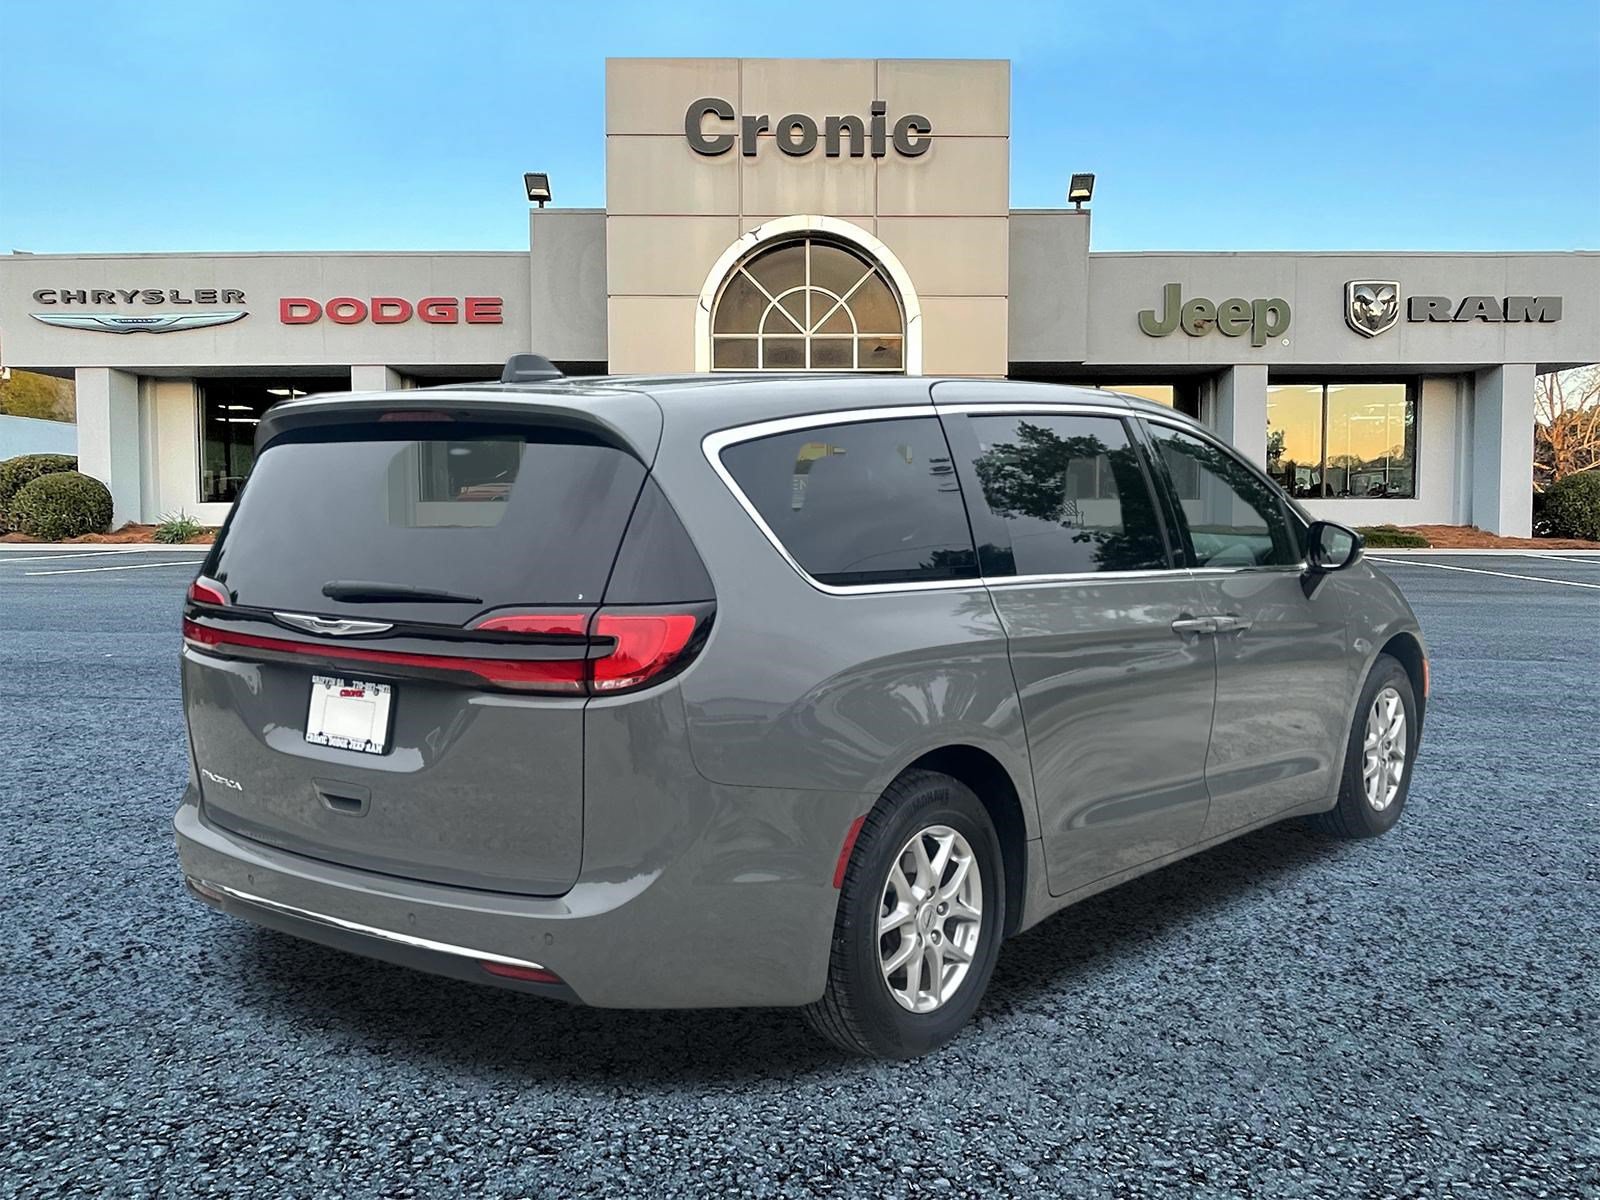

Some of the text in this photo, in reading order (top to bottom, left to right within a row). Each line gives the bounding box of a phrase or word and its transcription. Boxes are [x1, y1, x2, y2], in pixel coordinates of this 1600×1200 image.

[685, 97, 932, 158] Cronic
[32, 289, 246, 304] CHRYSLER
[1407, 296, 1563, 322] RAM
[280, 297, 503, 324] DODGE
[1138, 283, 1291, 347] Jeep
